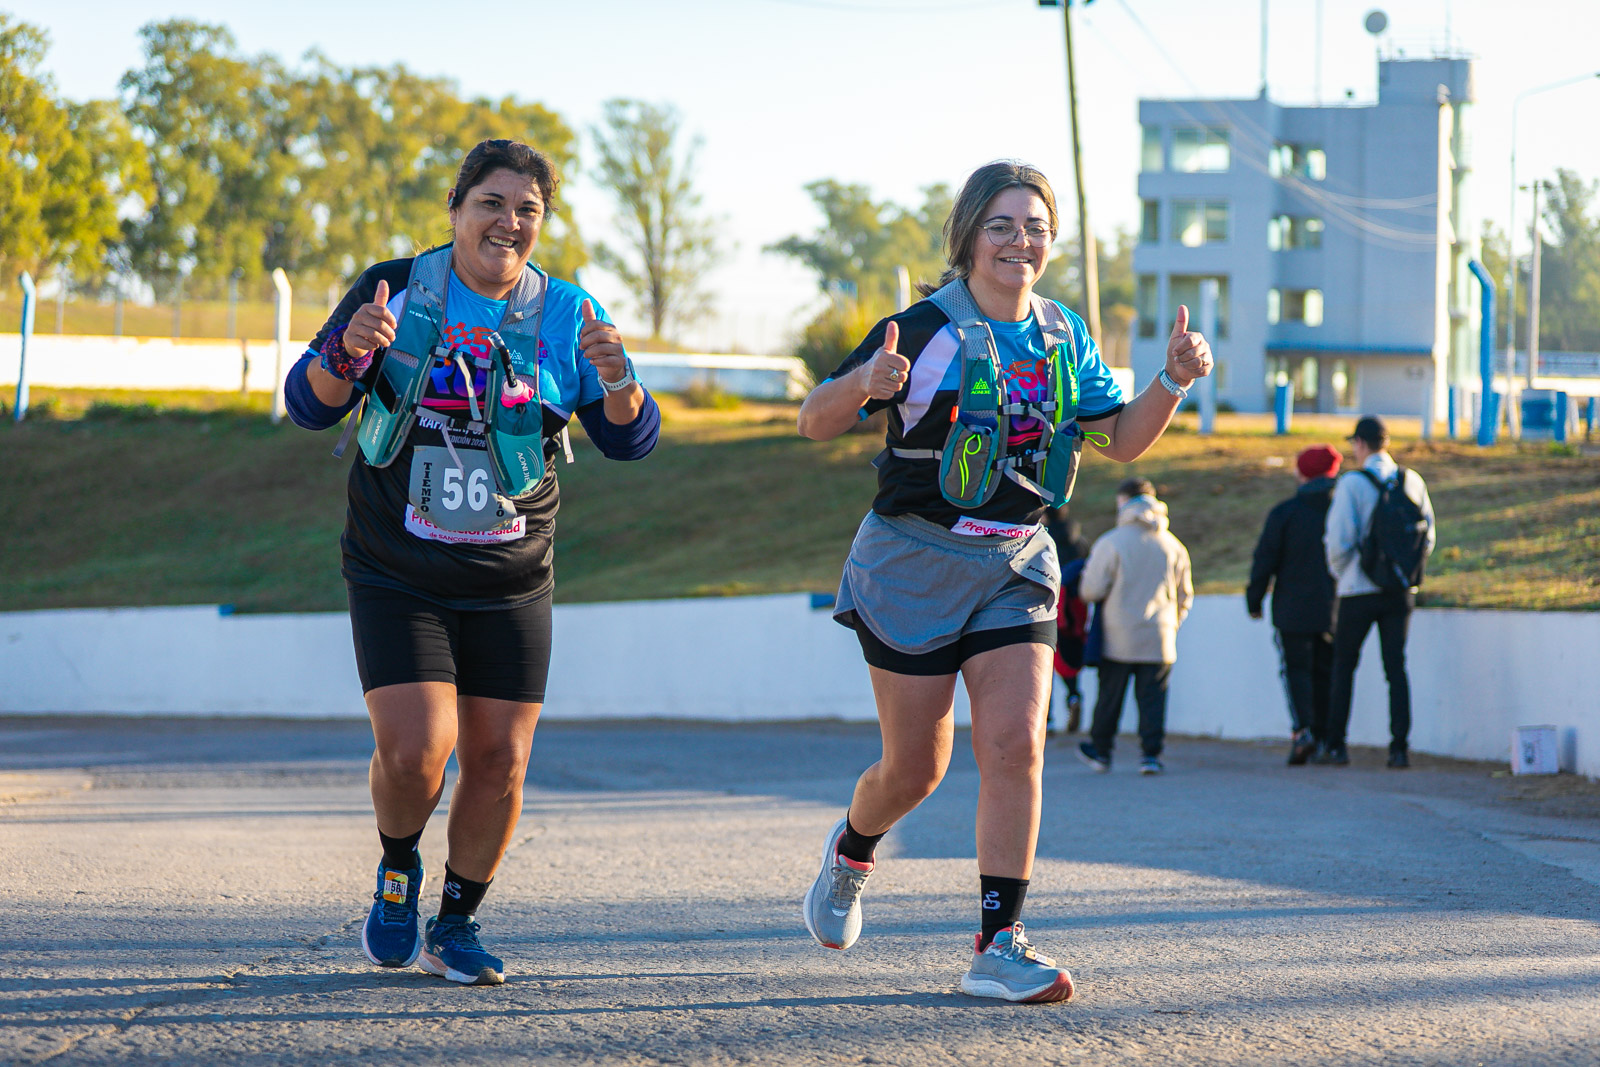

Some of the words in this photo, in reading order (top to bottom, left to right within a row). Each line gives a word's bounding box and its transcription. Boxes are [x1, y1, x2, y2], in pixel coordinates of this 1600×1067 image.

[420, 462, 433, 513] TIEMPO
[441, 467, 489, 512] 56
[515, 451, 530, 484] AONIJIE
